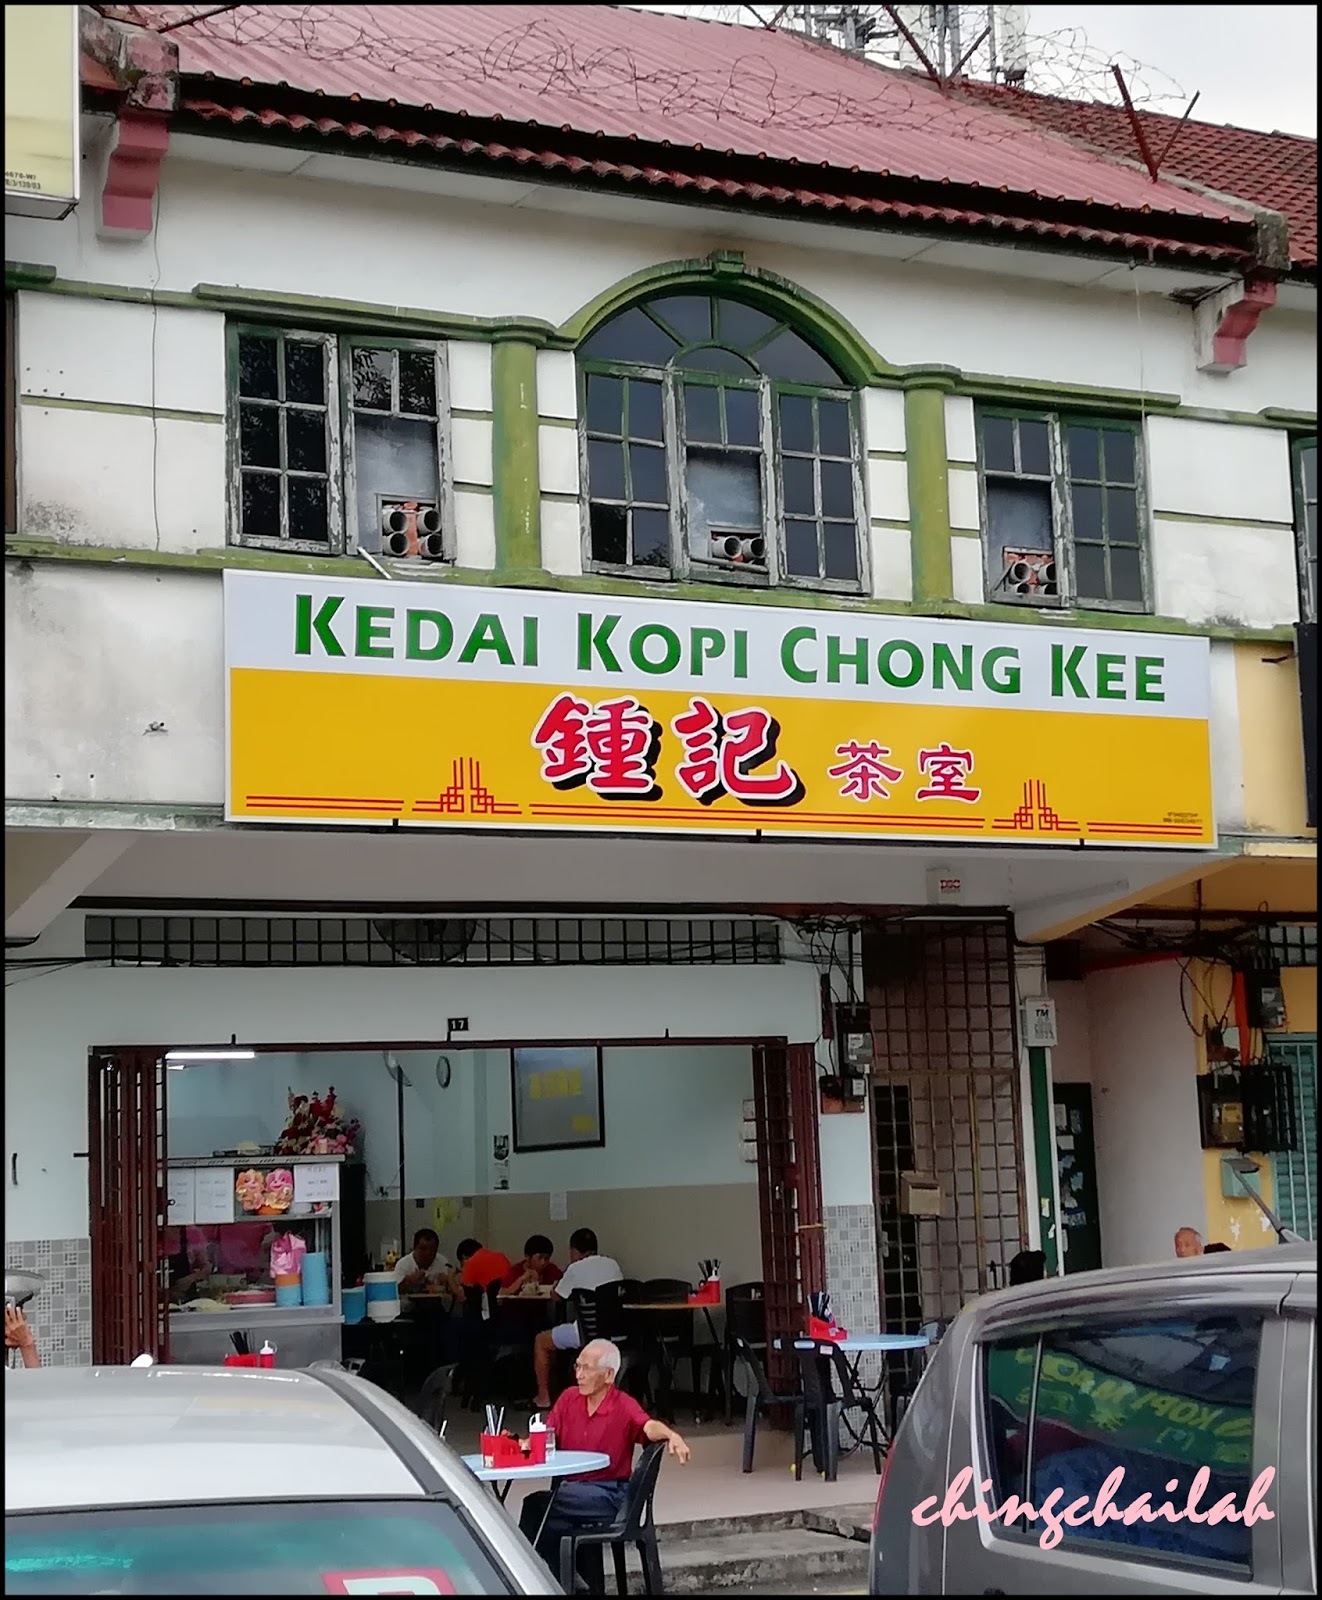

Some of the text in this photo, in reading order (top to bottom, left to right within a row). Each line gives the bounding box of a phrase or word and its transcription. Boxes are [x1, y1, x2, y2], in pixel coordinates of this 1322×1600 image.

[294, 593, 1165, 702] KEDAI KOPI CHONG KEE
[531, 691, 981, 804] 鍾記 茶室
[451, 1019, 465, 1030] 17
[1035, 1009, 1049, 1017] TM
